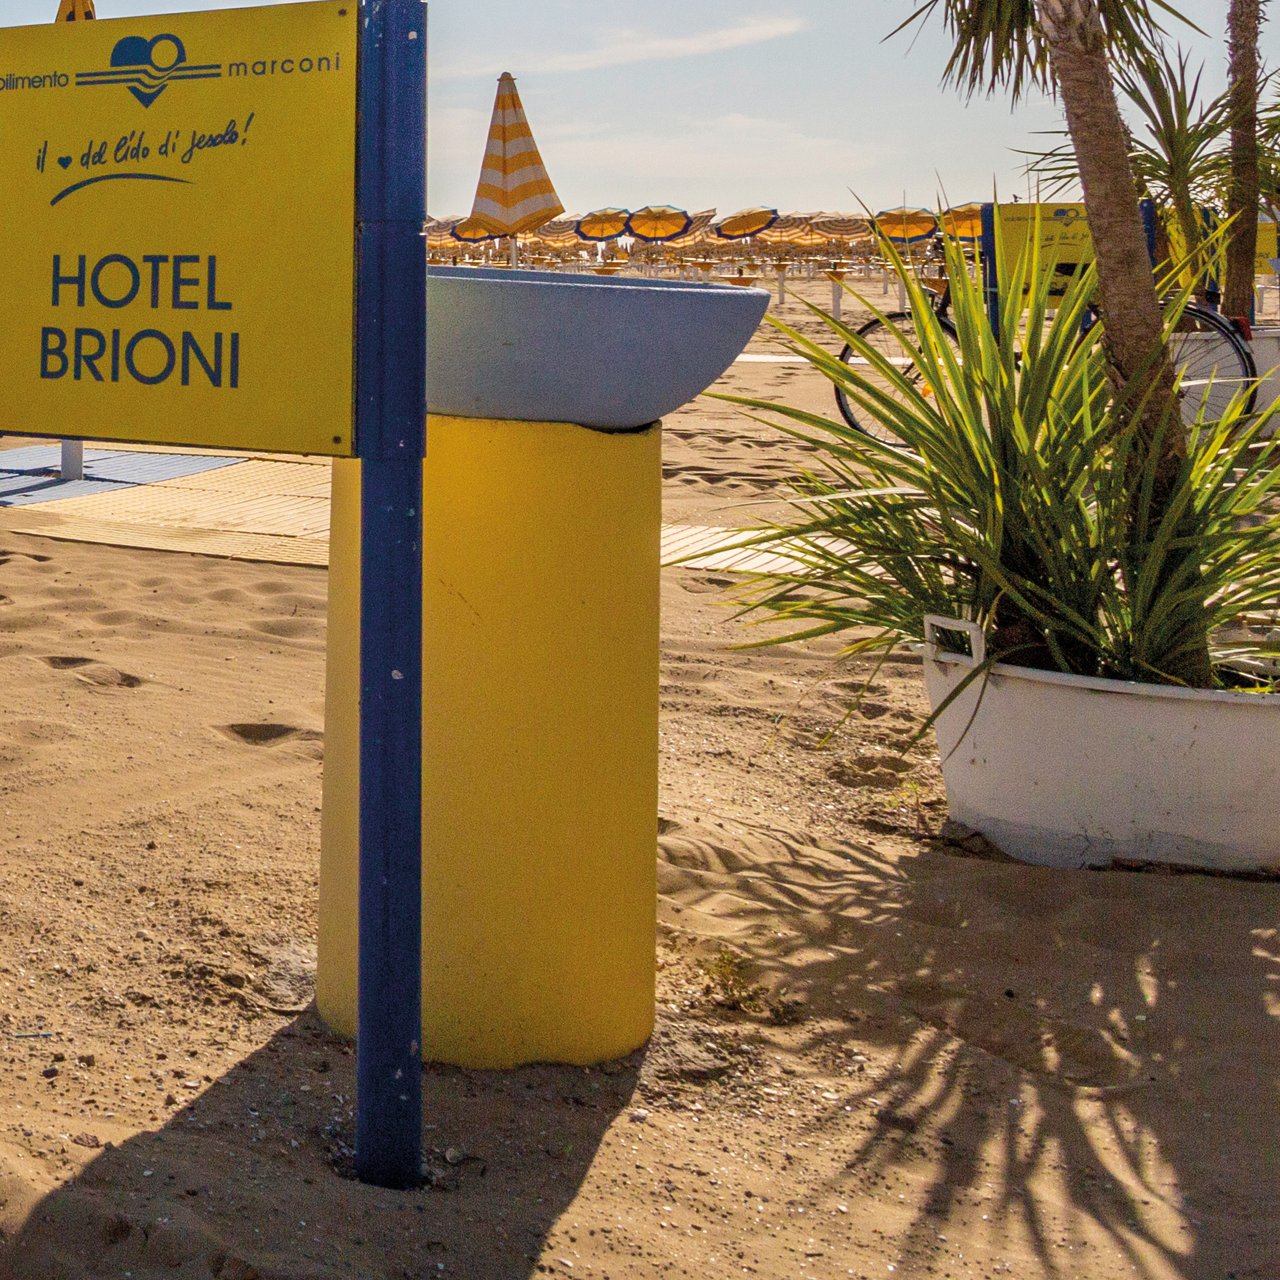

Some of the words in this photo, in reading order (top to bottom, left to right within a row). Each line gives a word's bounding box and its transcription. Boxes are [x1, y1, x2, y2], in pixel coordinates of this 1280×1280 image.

[228, 52, 341, 77] marconi
[36, 140, 48, 174] il
[80, 140, 108, 170] del
[158, 130, 180, 157] di
[51, 253, 233, 310] HOTEL
[40, 326, 240, 389] BRIONI
